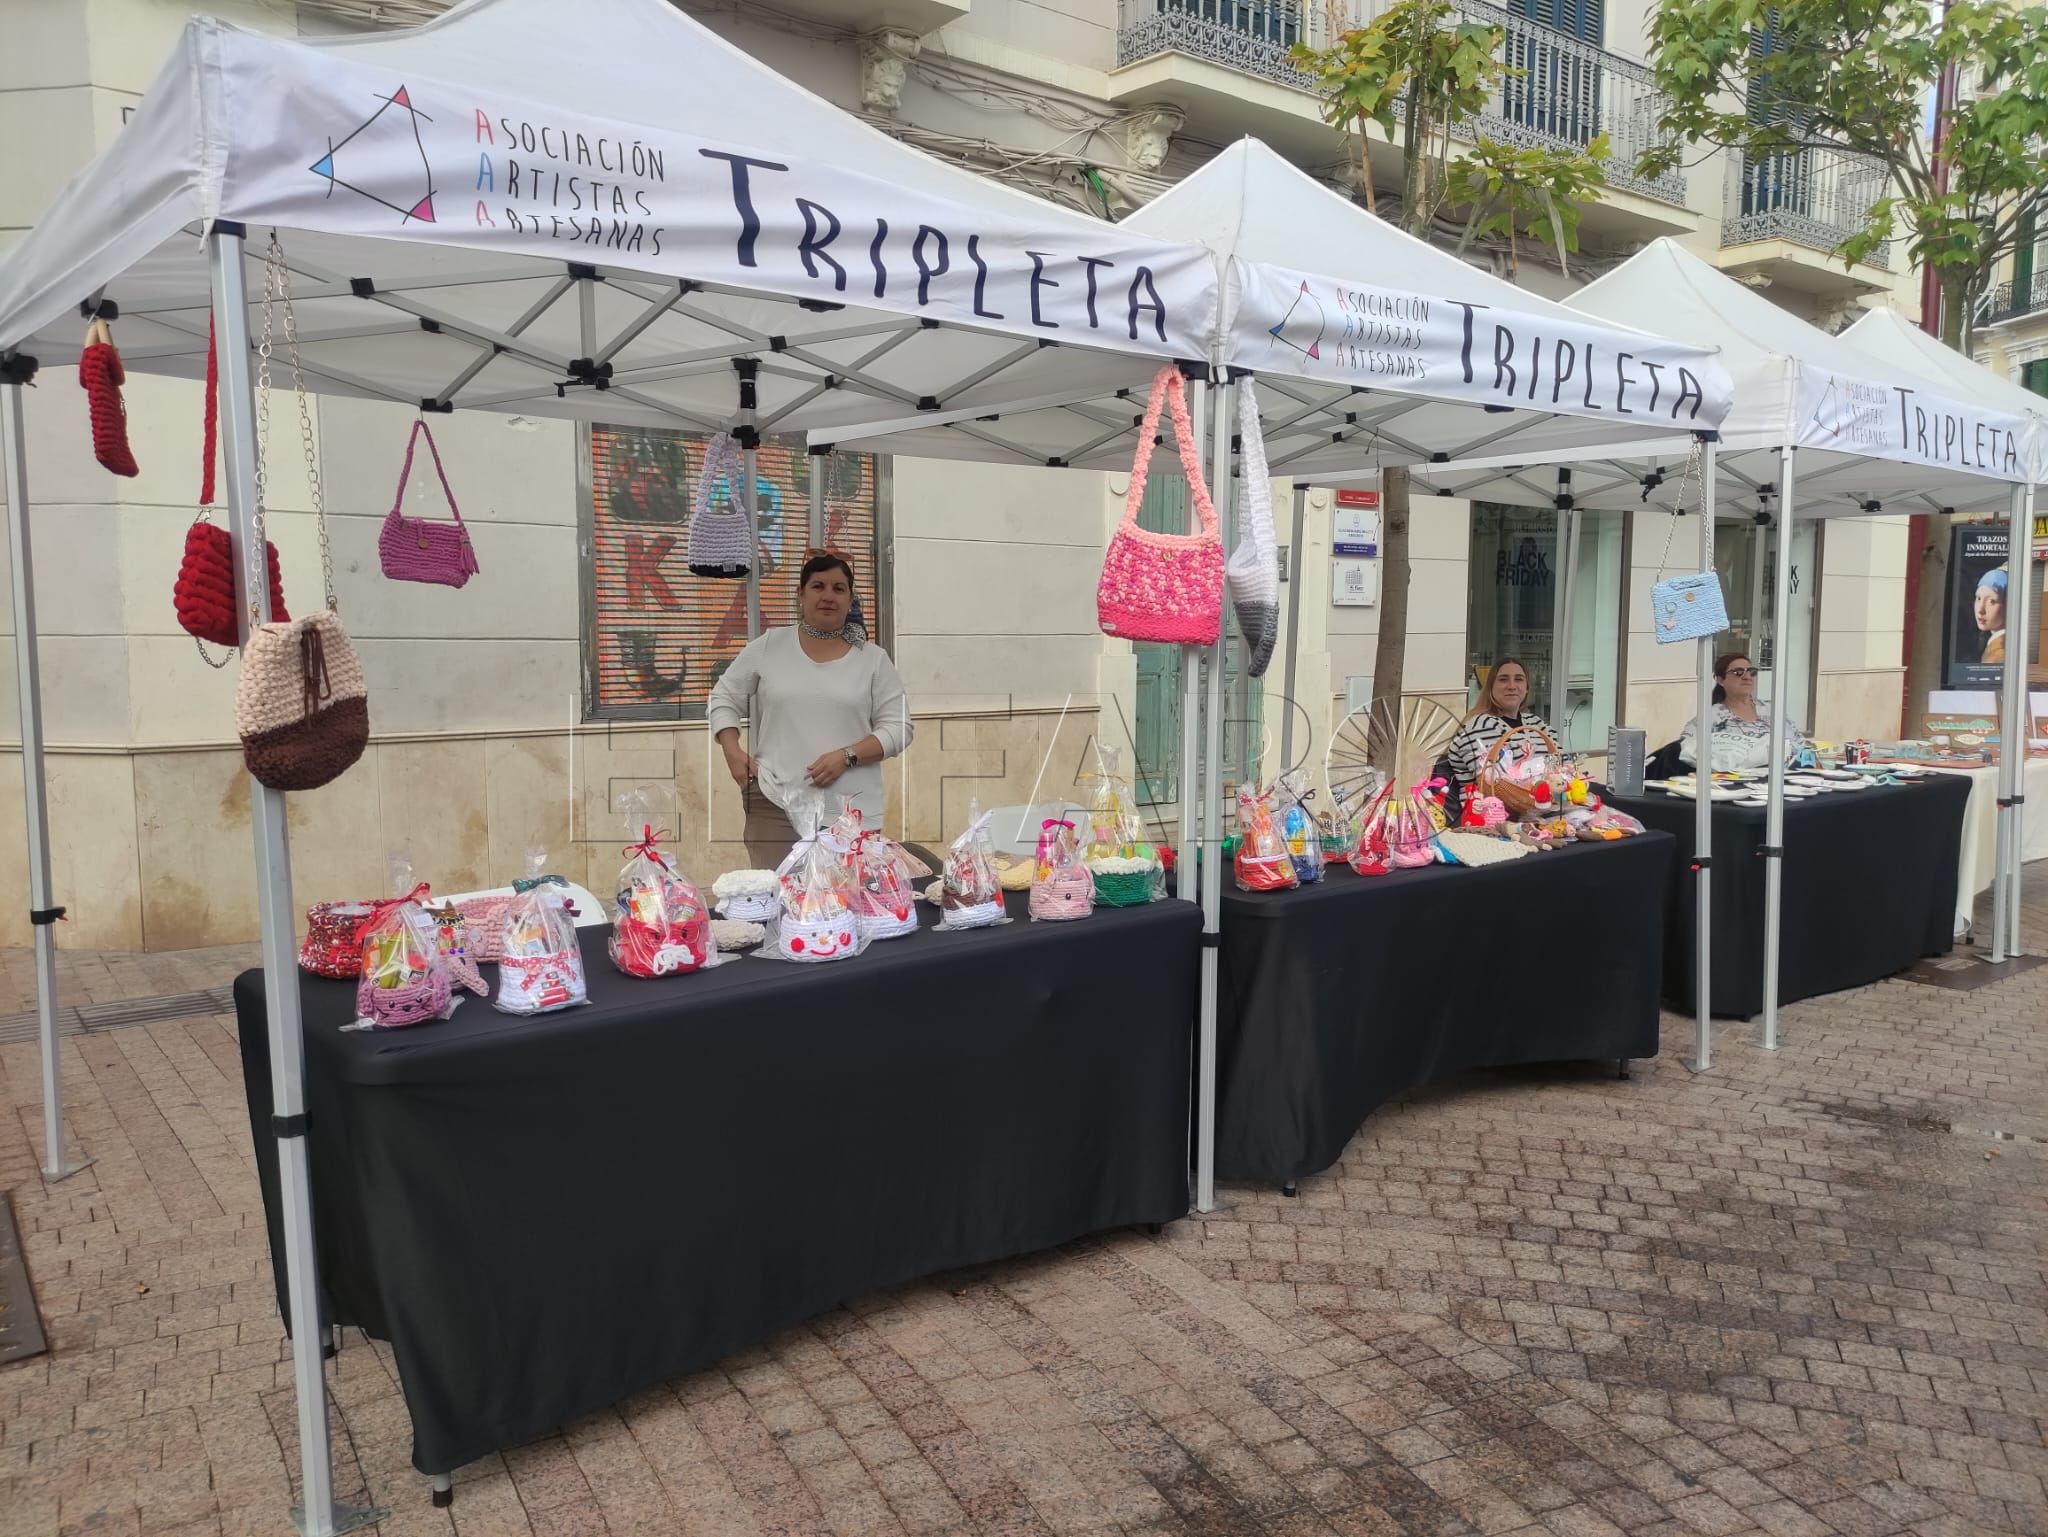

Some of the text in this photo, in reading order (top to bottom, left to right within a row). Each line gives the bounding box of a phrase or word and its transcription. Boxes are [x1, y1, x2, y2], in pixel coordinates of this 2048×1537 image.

[476, 108, 665, 182] ASOCIACIÓN
[477, 152, 652, 216] ARTISTAS
[476, 200, 665, 255] ARTESANAS
[698, 148, 1167, 342] TRIPLETA
[1336, 286, 1430, 323] ASOCIACIÓN
[1344, 312, 1422, 350] ARTISTAS
[1336, 342, 1427, 379] ARTESANAS
[1445, 299, 1704, 419] TRIPLETA
[1893, 386, 2017, 474] TRIPLETA
[1966, 543, 2010, 551] INMORTAL
[1976, 535, 2008, 543] TRAZOS
[1496, 567, 1550, 586] FRIDAY
[1497, 550, 1548, 569] BLACK
